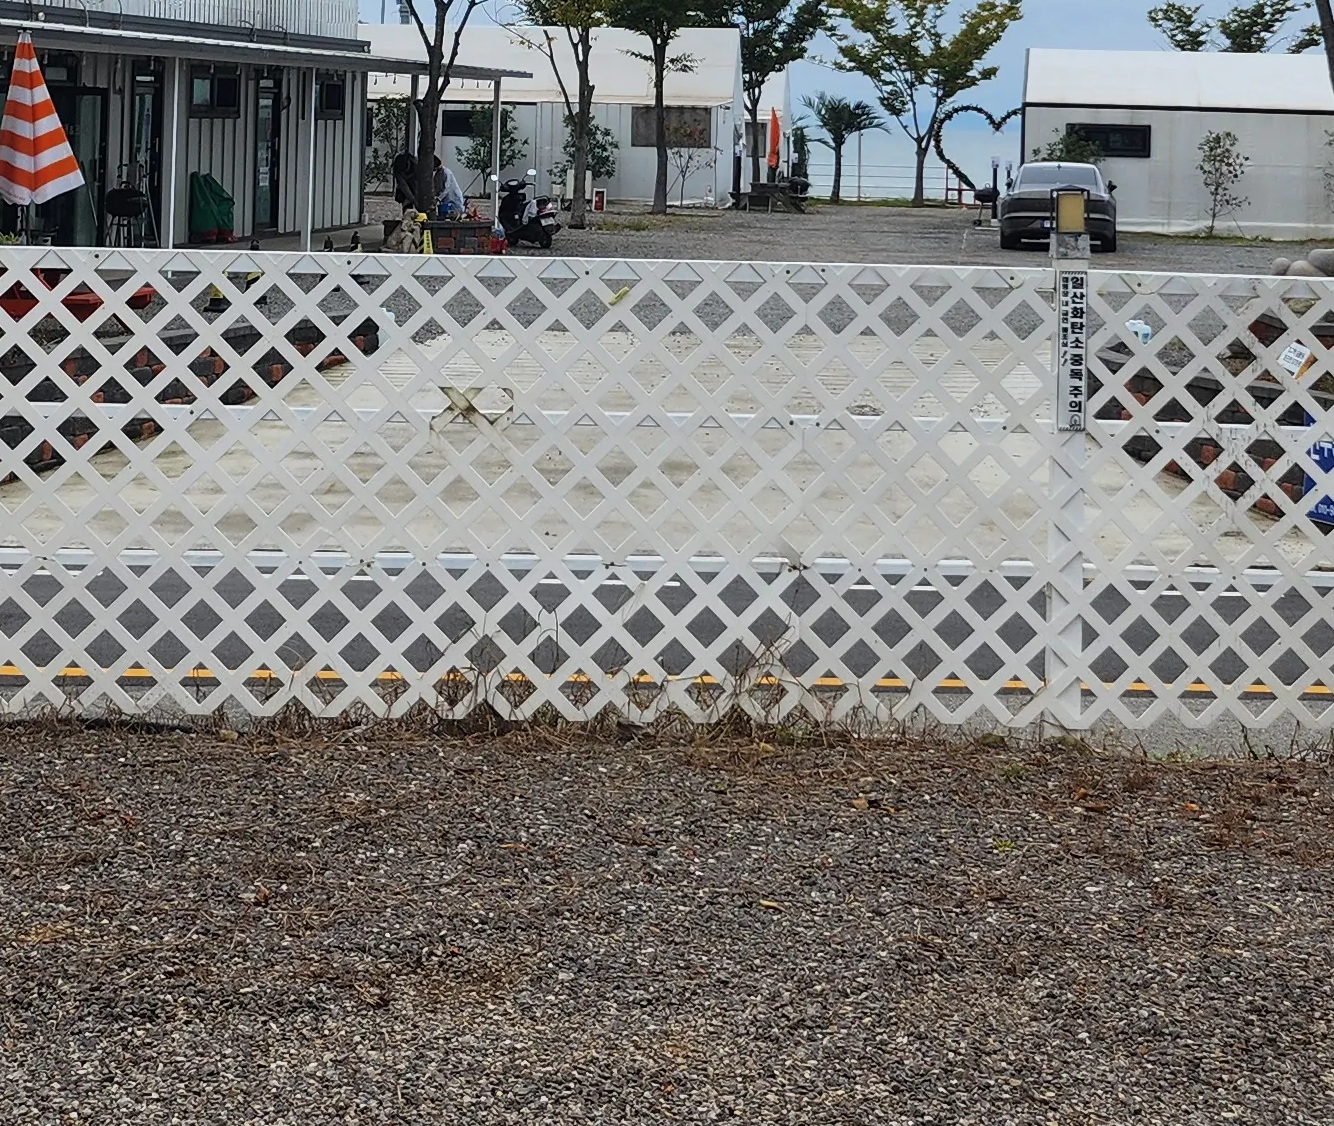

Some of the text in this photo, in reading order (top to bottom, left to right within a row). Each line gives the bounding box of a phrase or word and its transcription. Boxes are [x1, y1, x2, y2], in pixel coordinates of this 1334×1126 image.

[1068, 275, 1086, 414] 일산화탄소 중독 주의
